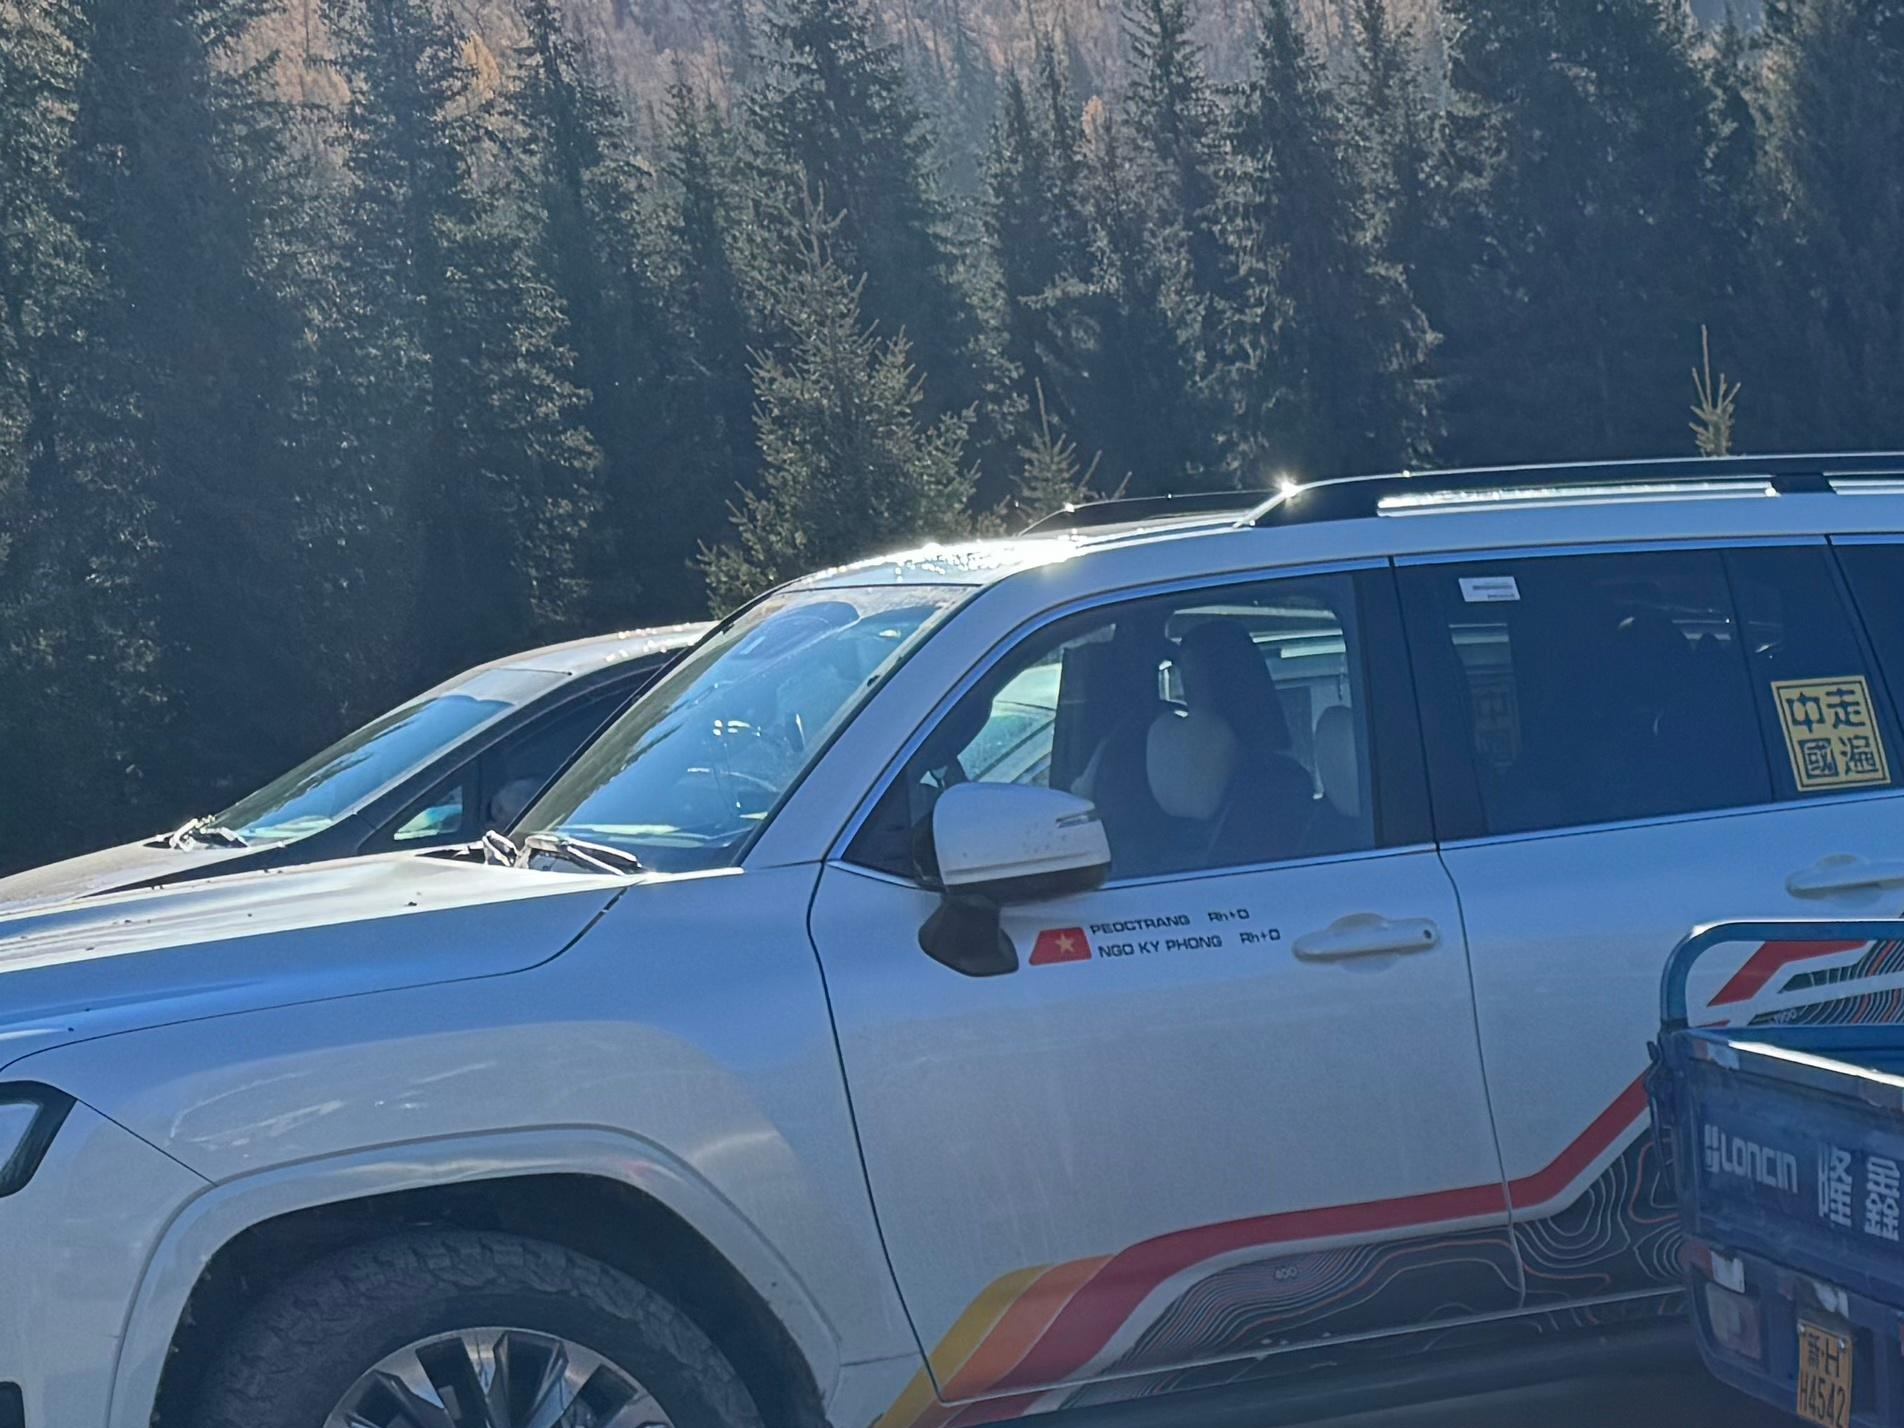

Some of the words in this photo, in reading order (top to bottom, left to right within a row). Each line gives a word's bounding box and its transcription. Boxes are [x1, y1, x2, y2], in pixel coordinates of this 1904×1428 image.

[1098, 943, 1135, 959] NGO
[1138, 941, 1160, 955] KY
[1165, 935, 1223, 951] PHONG
[1817, 1142, 1901, 1242] 隆鑫
